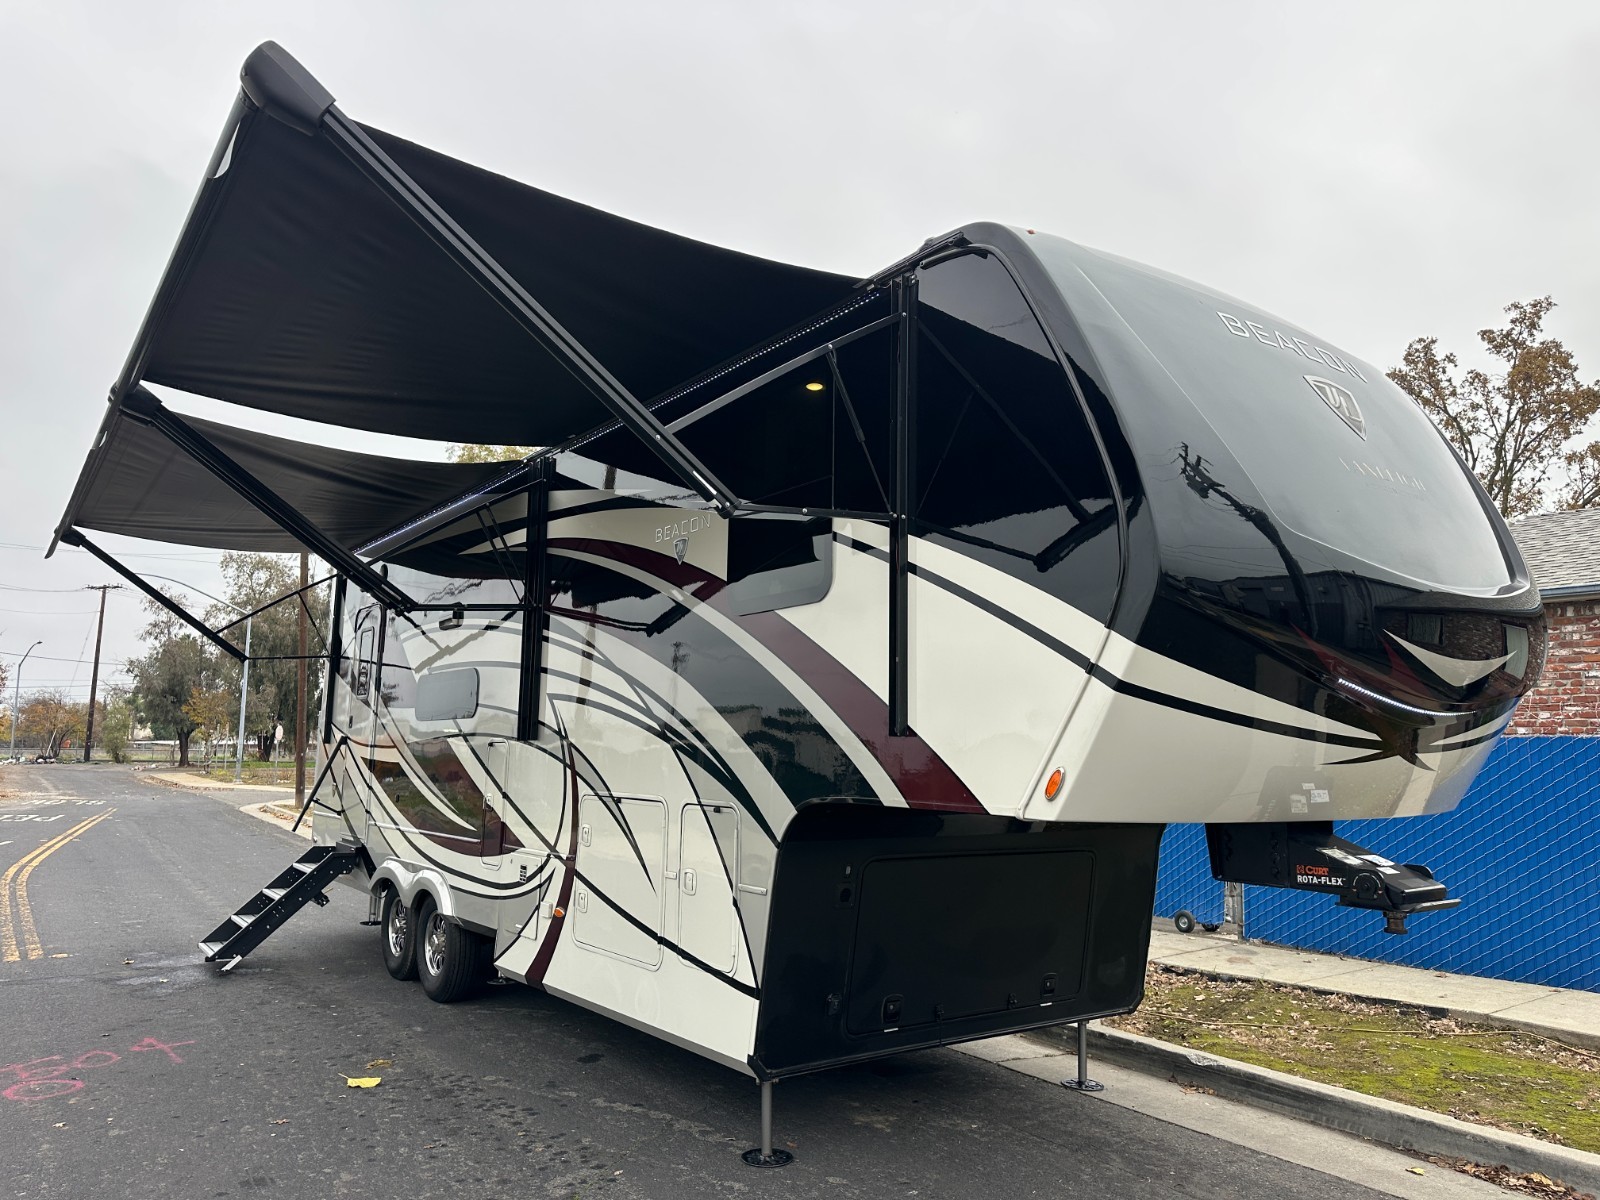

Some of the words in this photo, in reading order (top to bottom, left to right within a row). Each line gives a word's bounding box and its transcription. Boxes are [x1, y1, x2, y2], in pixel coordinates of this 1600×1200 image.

[1215, 311, 1368, 384] BEACON
[655, 513, 711, 543] BEACON
[1305, 865, 1329, 875] CURT
[1297, 875, 1344, 886] ROTA-FLEX
